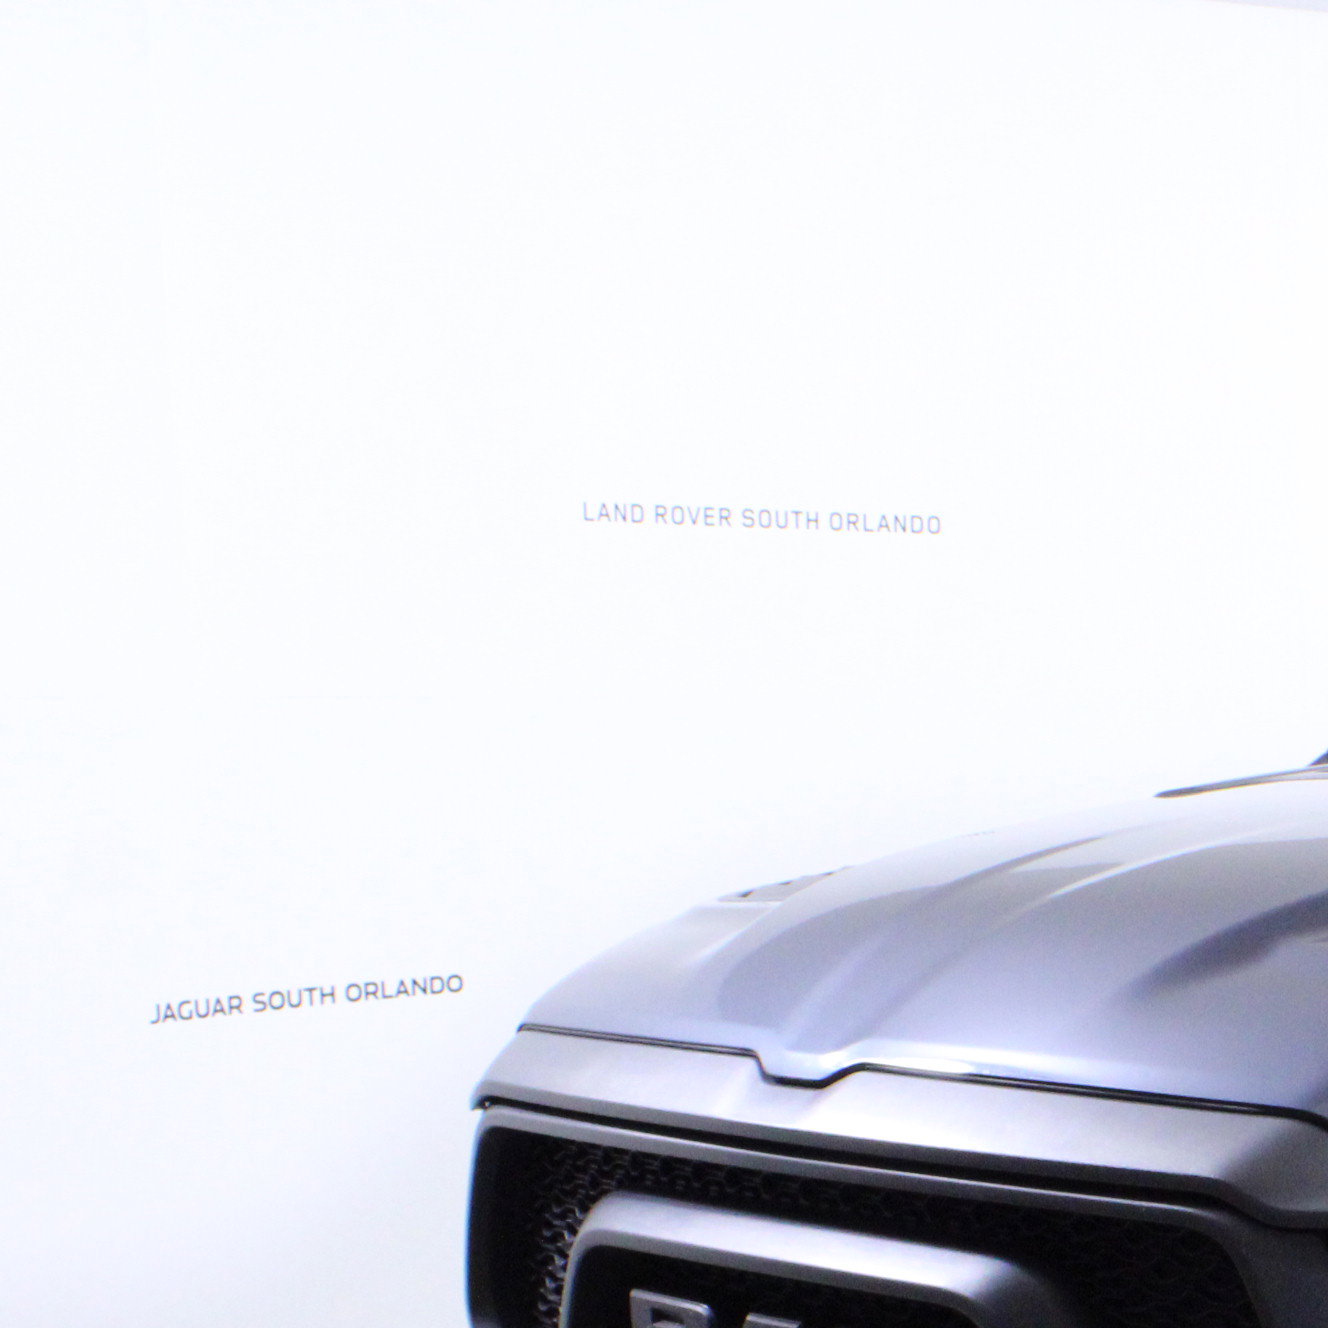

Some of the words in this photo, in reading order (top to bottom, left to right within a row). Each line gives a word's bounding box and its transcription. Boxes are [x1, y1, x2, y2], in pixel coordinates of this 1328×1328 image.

[582, 500, 645, 525] LAND
[654, 503, 733, 528] ROVER
[741, 506, 820, 532] SOUTH
[829, 510, 943, 536] ORLANDO
[149, 994, 244, 1025] JAGUAR
[251, 984, 337, 1014] SOUTH
[344, 973, 466, 1004] ORLANDO
